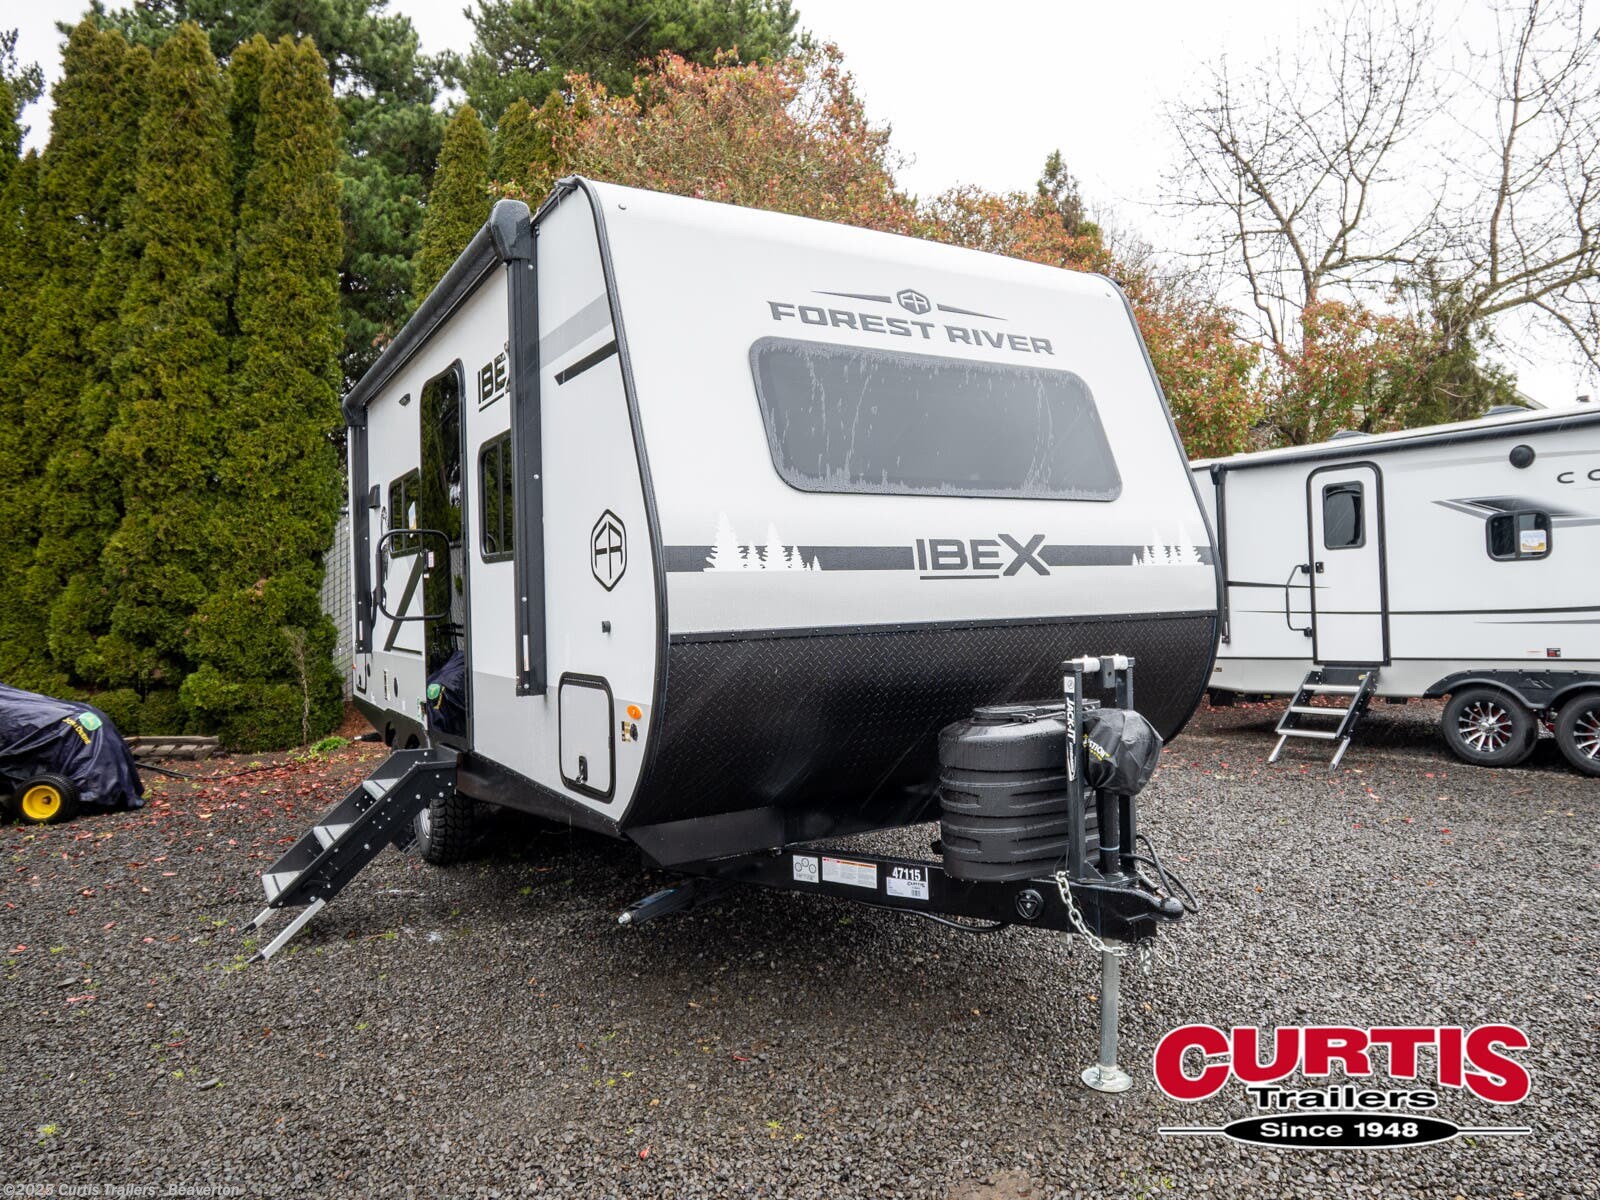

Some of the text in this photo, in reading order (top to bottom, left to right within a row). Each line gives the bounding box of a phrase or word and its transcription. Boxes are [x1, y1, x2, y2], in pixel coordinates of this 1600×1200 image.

[766, 301, 1055, 355] FOREST RIVER
[478, 341, 511, 405] IBE
[916, 534, 1051, 577] IBEX
[892, 866, 921, 881] 47115
